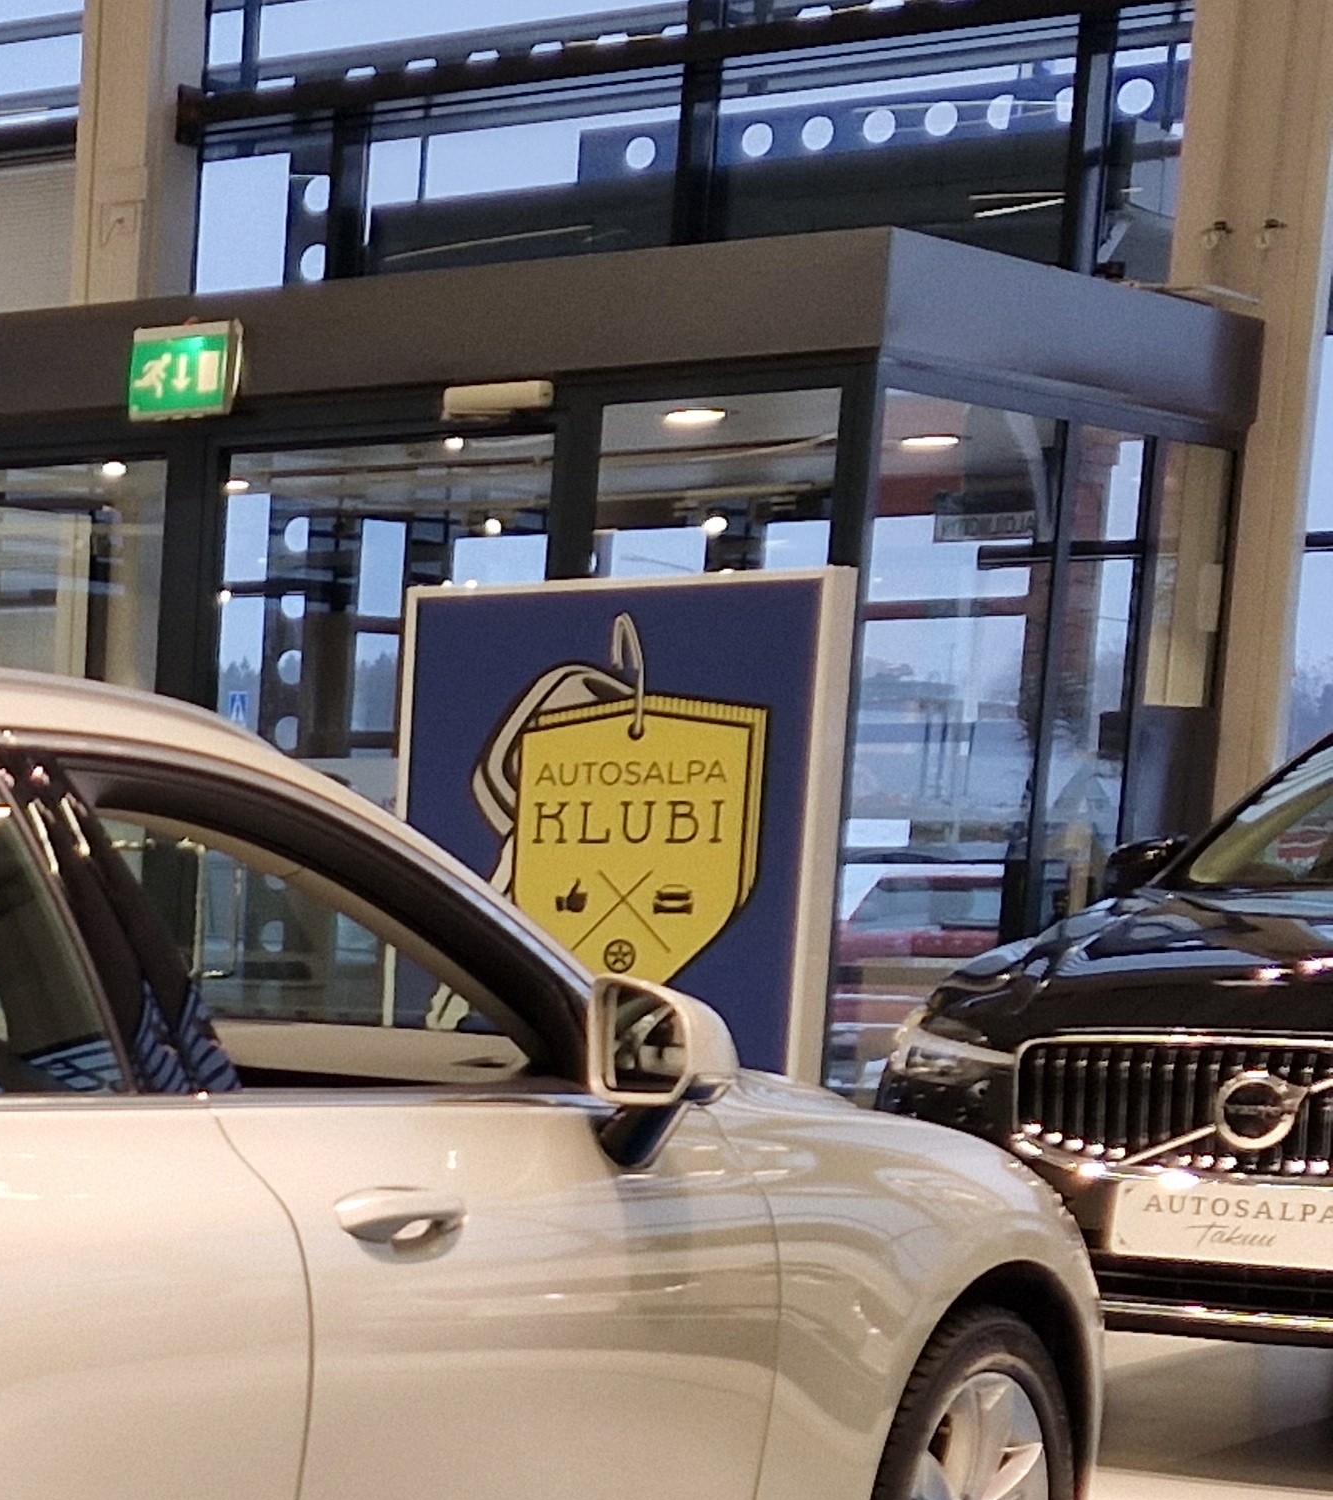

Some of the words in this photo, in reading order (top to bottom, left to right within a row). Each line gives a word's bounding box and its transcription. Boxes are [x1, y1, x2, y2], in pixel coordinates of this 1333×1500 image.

[534, 759, 727, 787] AUTOSALPA
[532, 800, 725, 844] KLUBI
[1143, 1194, 1333, 1224] AUTOSALPA
